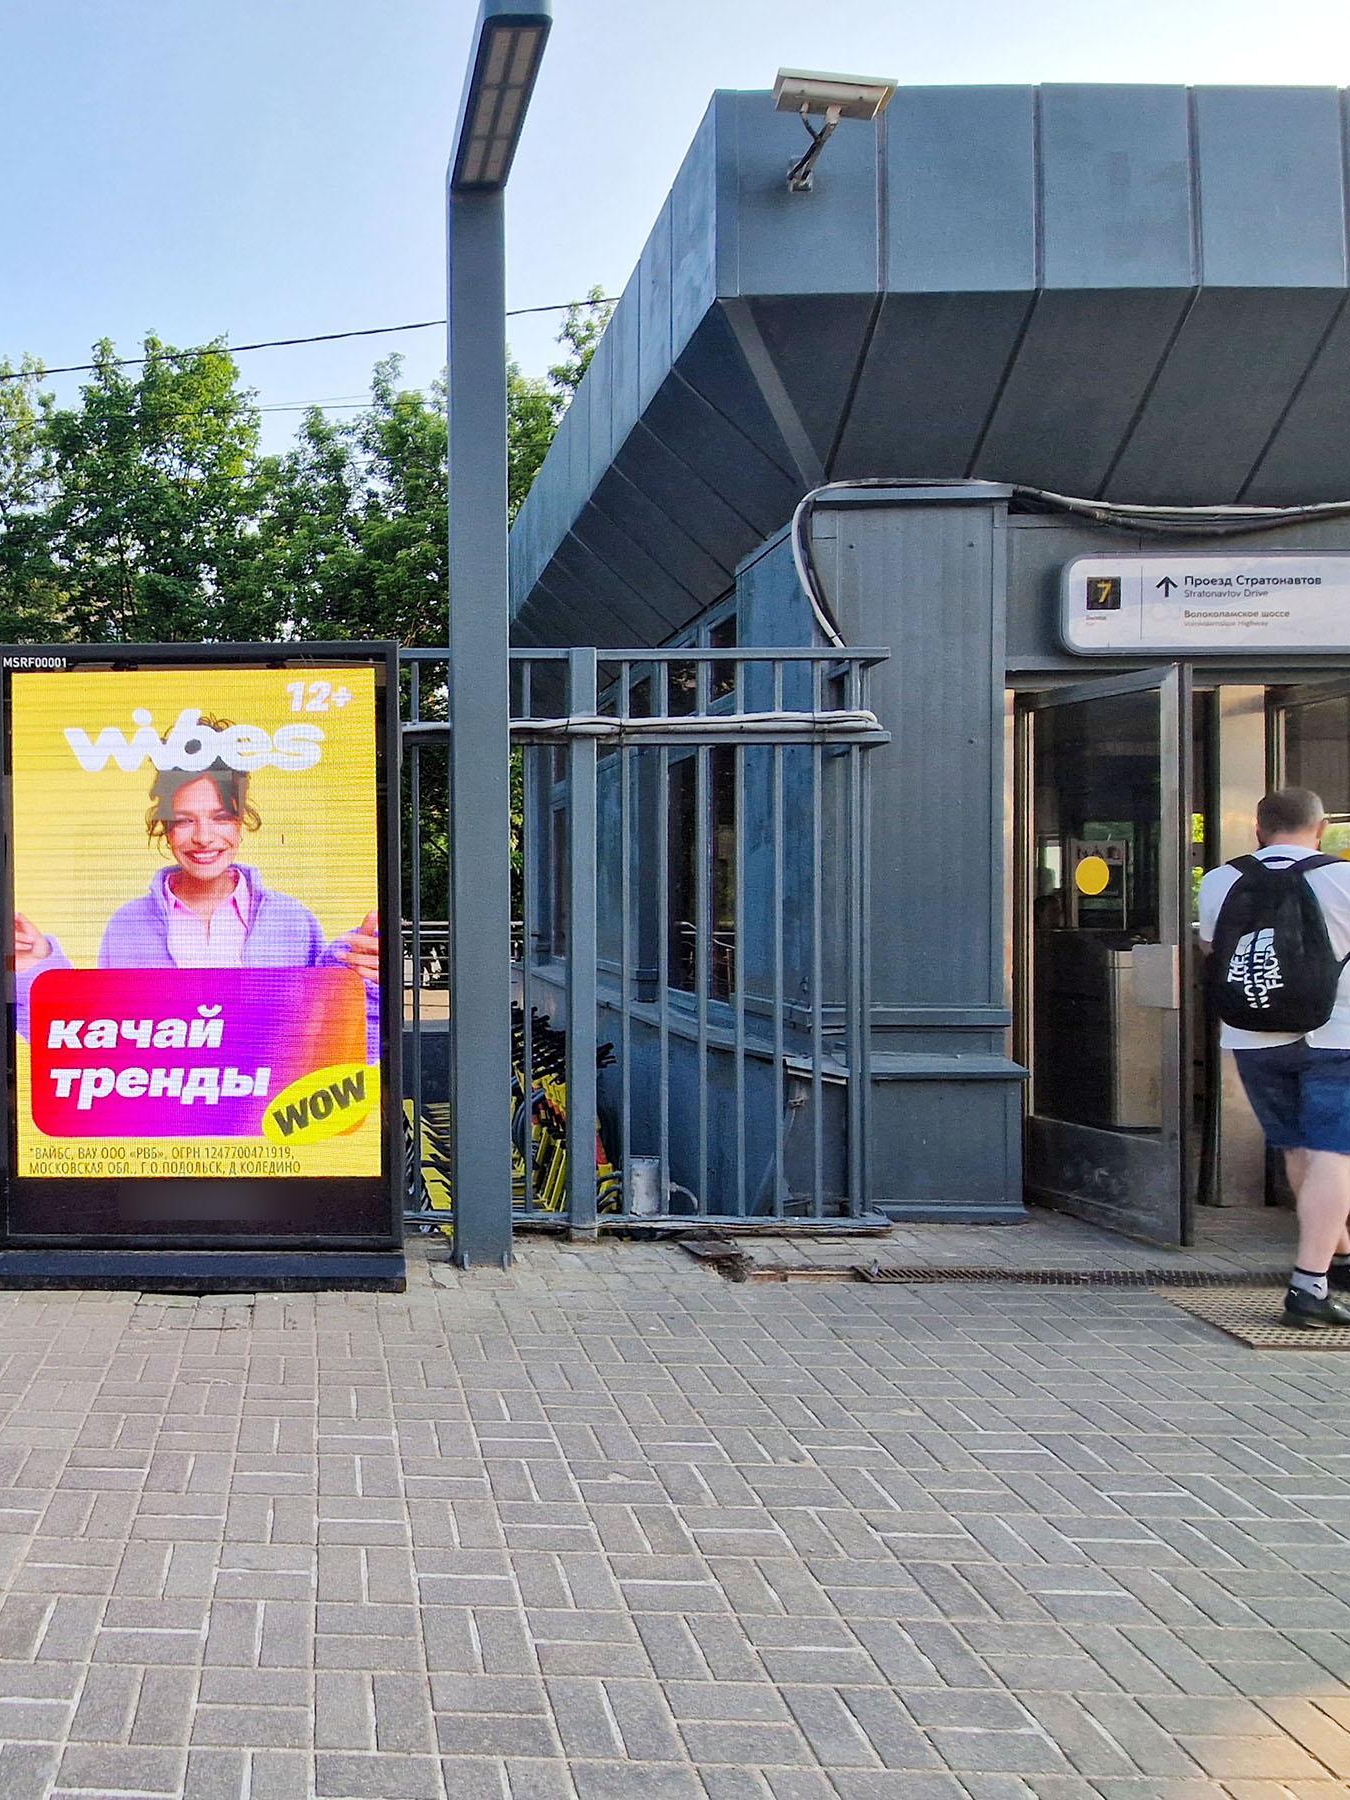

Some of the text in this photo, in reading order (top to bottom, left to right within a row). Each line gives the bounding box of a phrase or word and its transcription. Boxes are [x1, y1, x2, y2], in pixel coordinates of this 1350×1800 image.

[1184, 575, 1322, 588] Проезд Стратонавтов
[1097, 583, 1111, 603] 7
[1184, 589, 1269, 598] Stratonavtov Drive
[1184, 610, 1290, 618] Волоколамское шоссе
[3, 656, 67, 668] MSRF00001
[286, 681, 354, 712] 12+
[1227, 954, 1245, 982] THE
[47, 1004, 225, 1049] качай
[50, 1067, 272, 1110] тренды
[78, 1147, 98, 1159] ВАУ
[101, 1147, 126, 1159] ООО
[172, 1147, 201, 1159] ОГРН
[30, 1162, 104, 1175] МОСКОВСКАЯ
